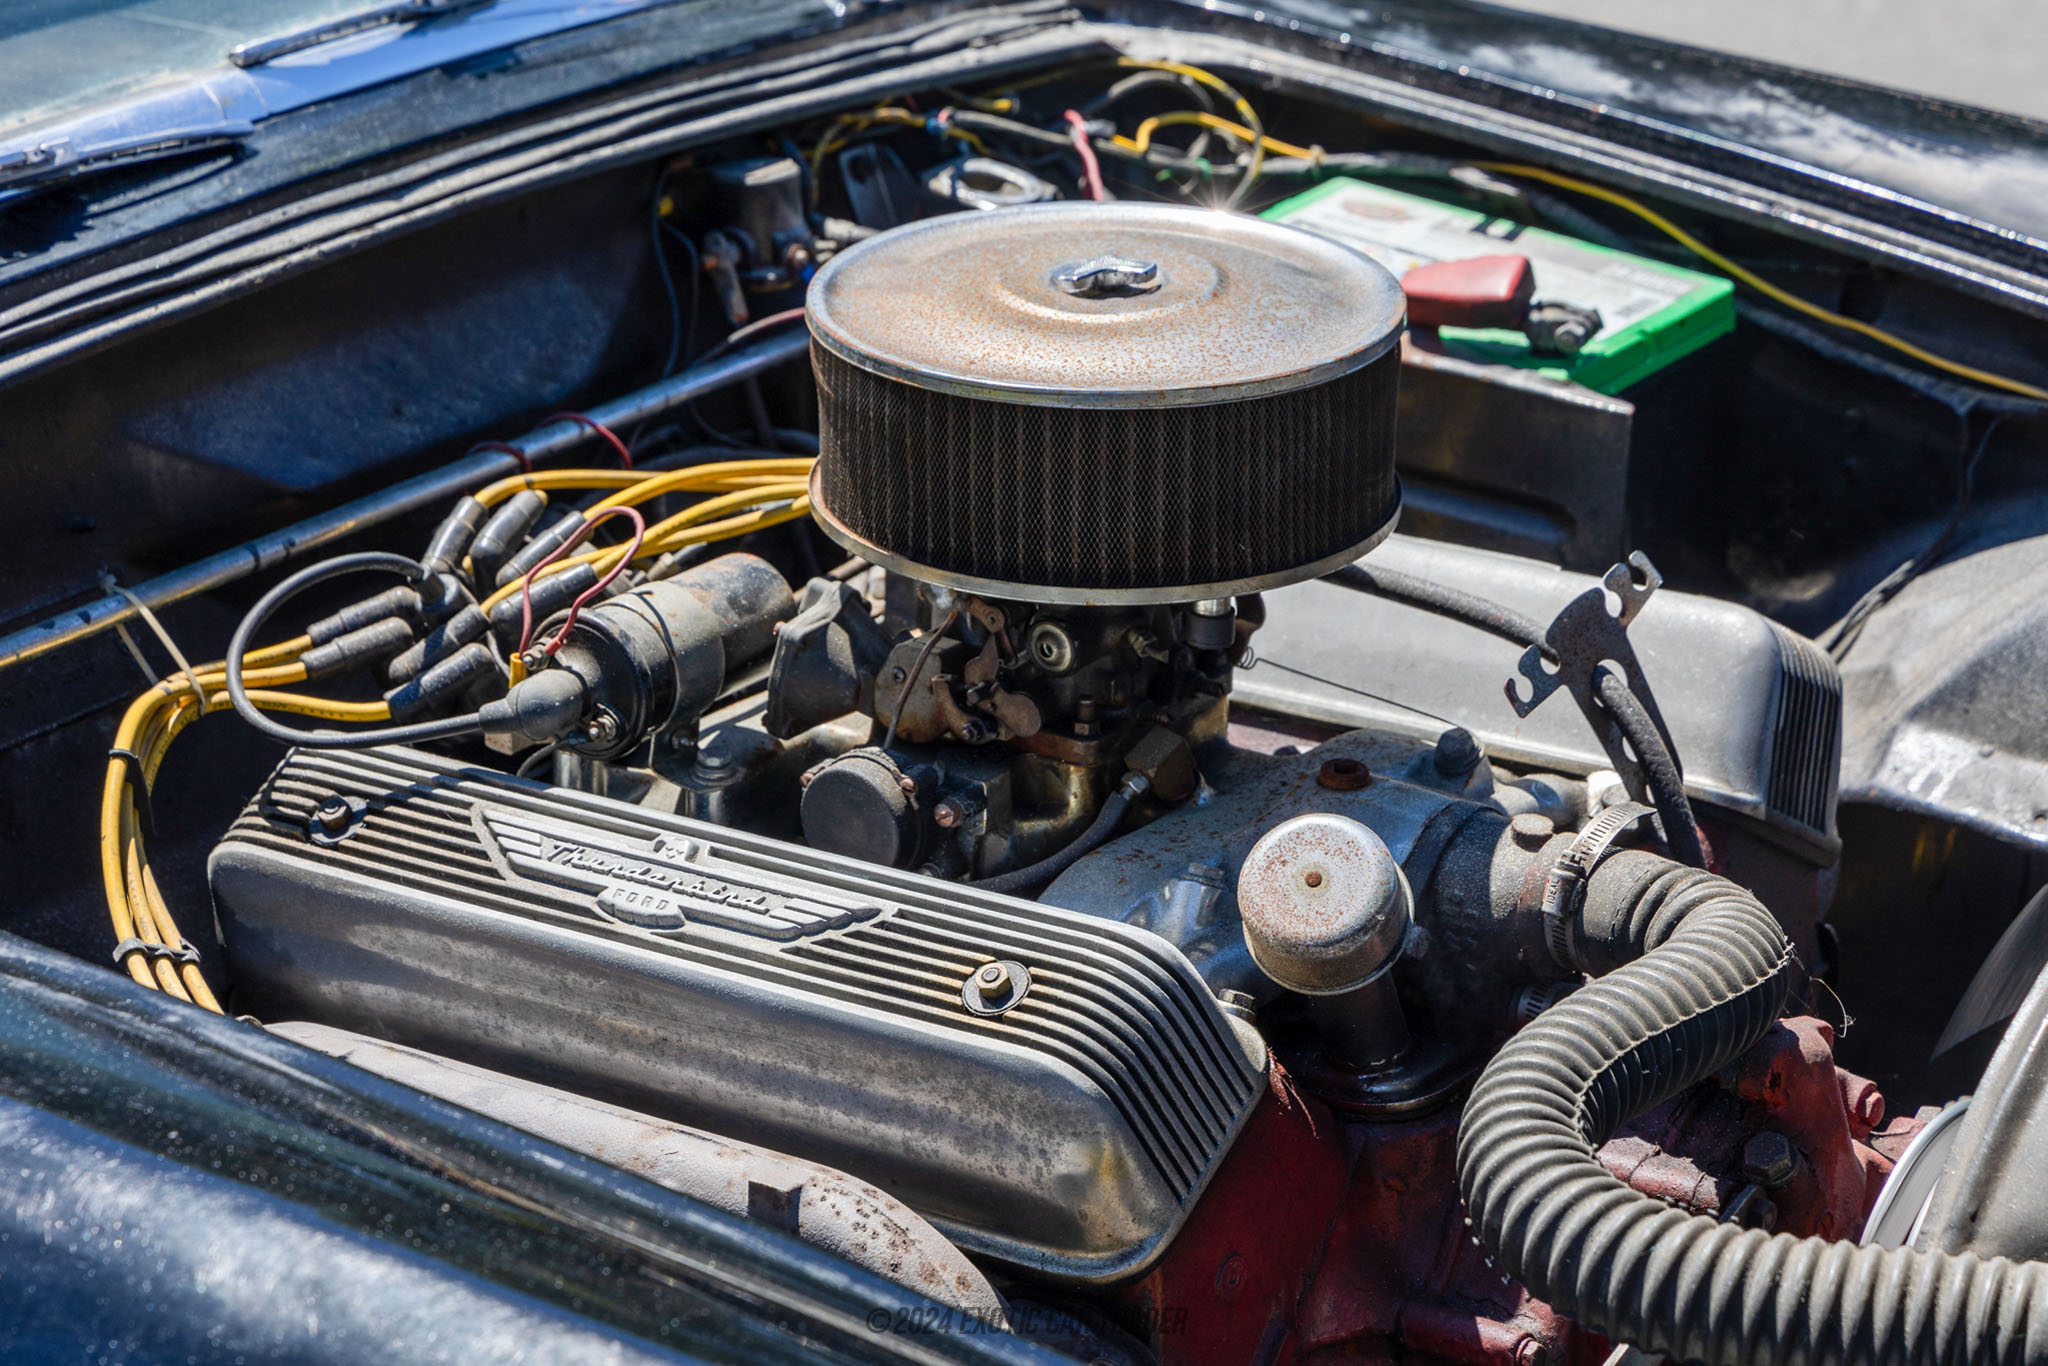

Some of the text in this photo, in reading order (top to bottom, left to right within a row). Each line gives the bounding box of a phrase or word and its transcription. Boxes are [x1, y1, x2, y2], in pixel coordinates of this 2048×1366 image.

[546, 843, 770, 915] Thunderbird
[1545, 878, 1560, 905] IDEAL
[612, 887, 670, 911] FORD
